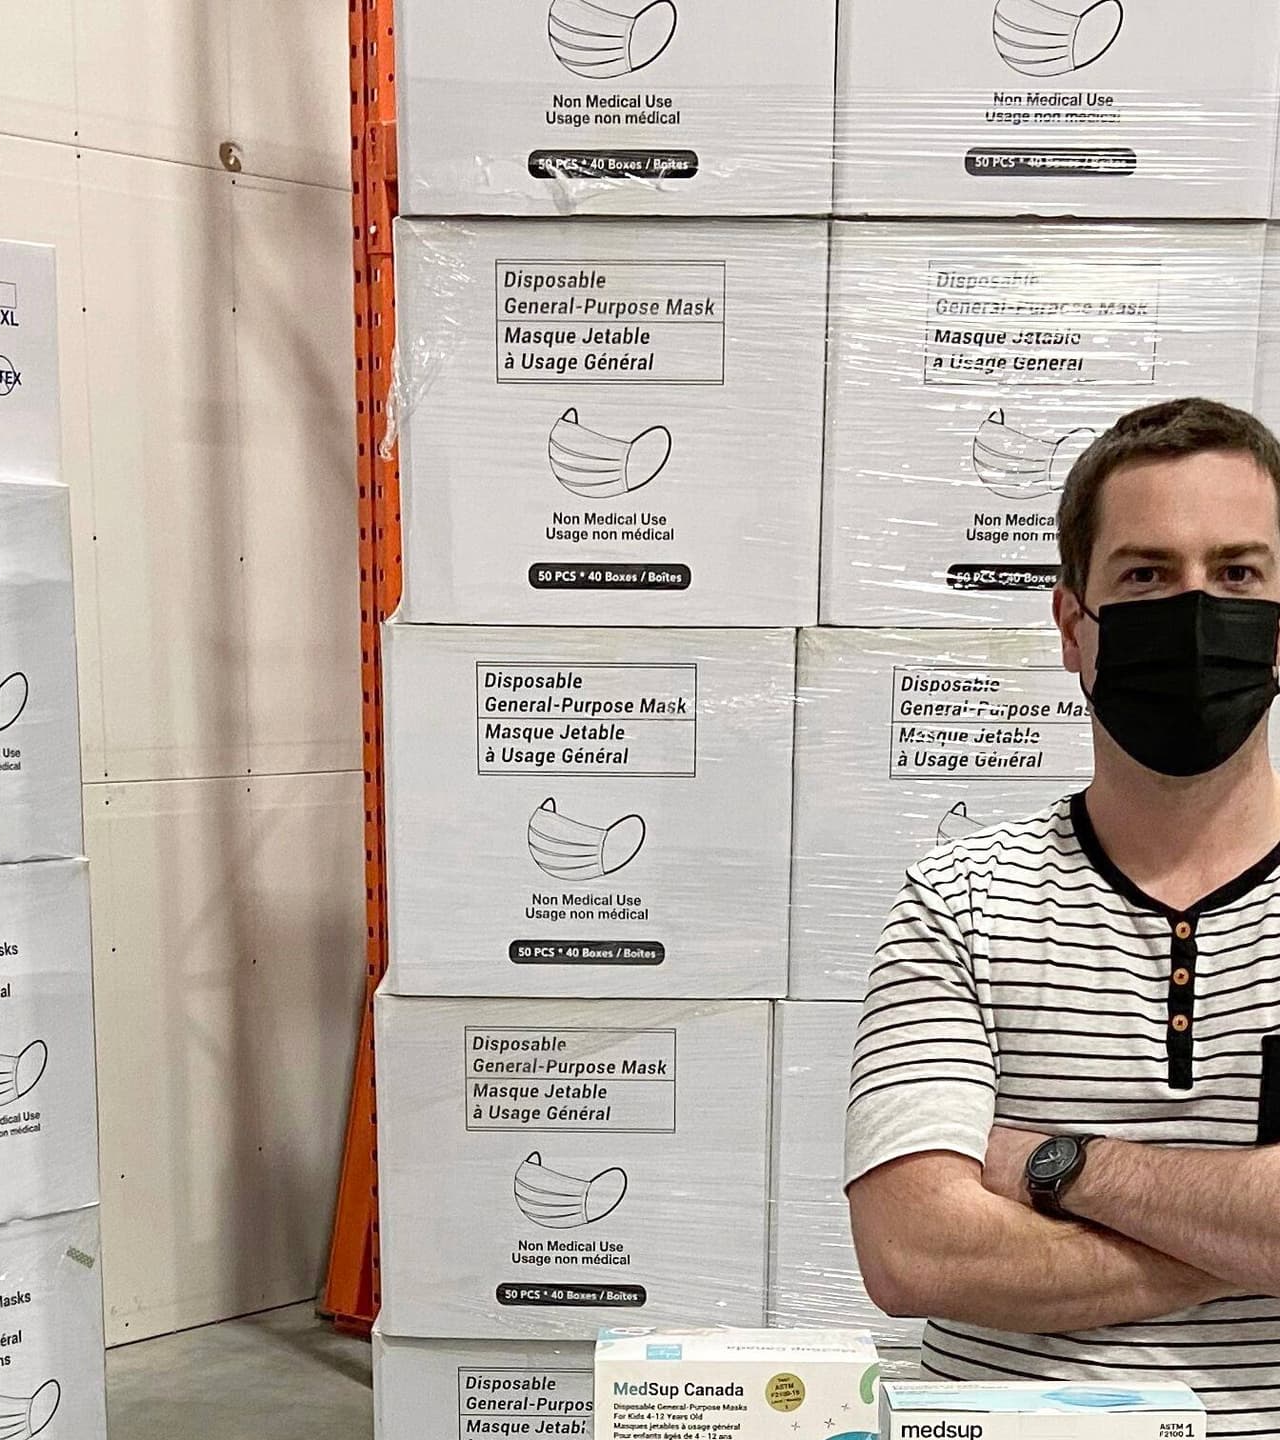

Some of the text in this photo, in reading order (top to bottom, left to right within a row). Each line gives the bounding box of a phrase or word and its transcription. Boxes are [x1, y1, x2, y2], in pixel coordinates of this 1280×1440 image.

[504, 271, 606, 292] Disposable
[0, 309, 19, 327] XL
[504, 298, 715, 318] General-Purpose Mask
[504, 327, 650, 347] Masque Jetable
[504, 352, 654, 373] à Usage Général
[1186, 1424, 1195, 1437] 1
